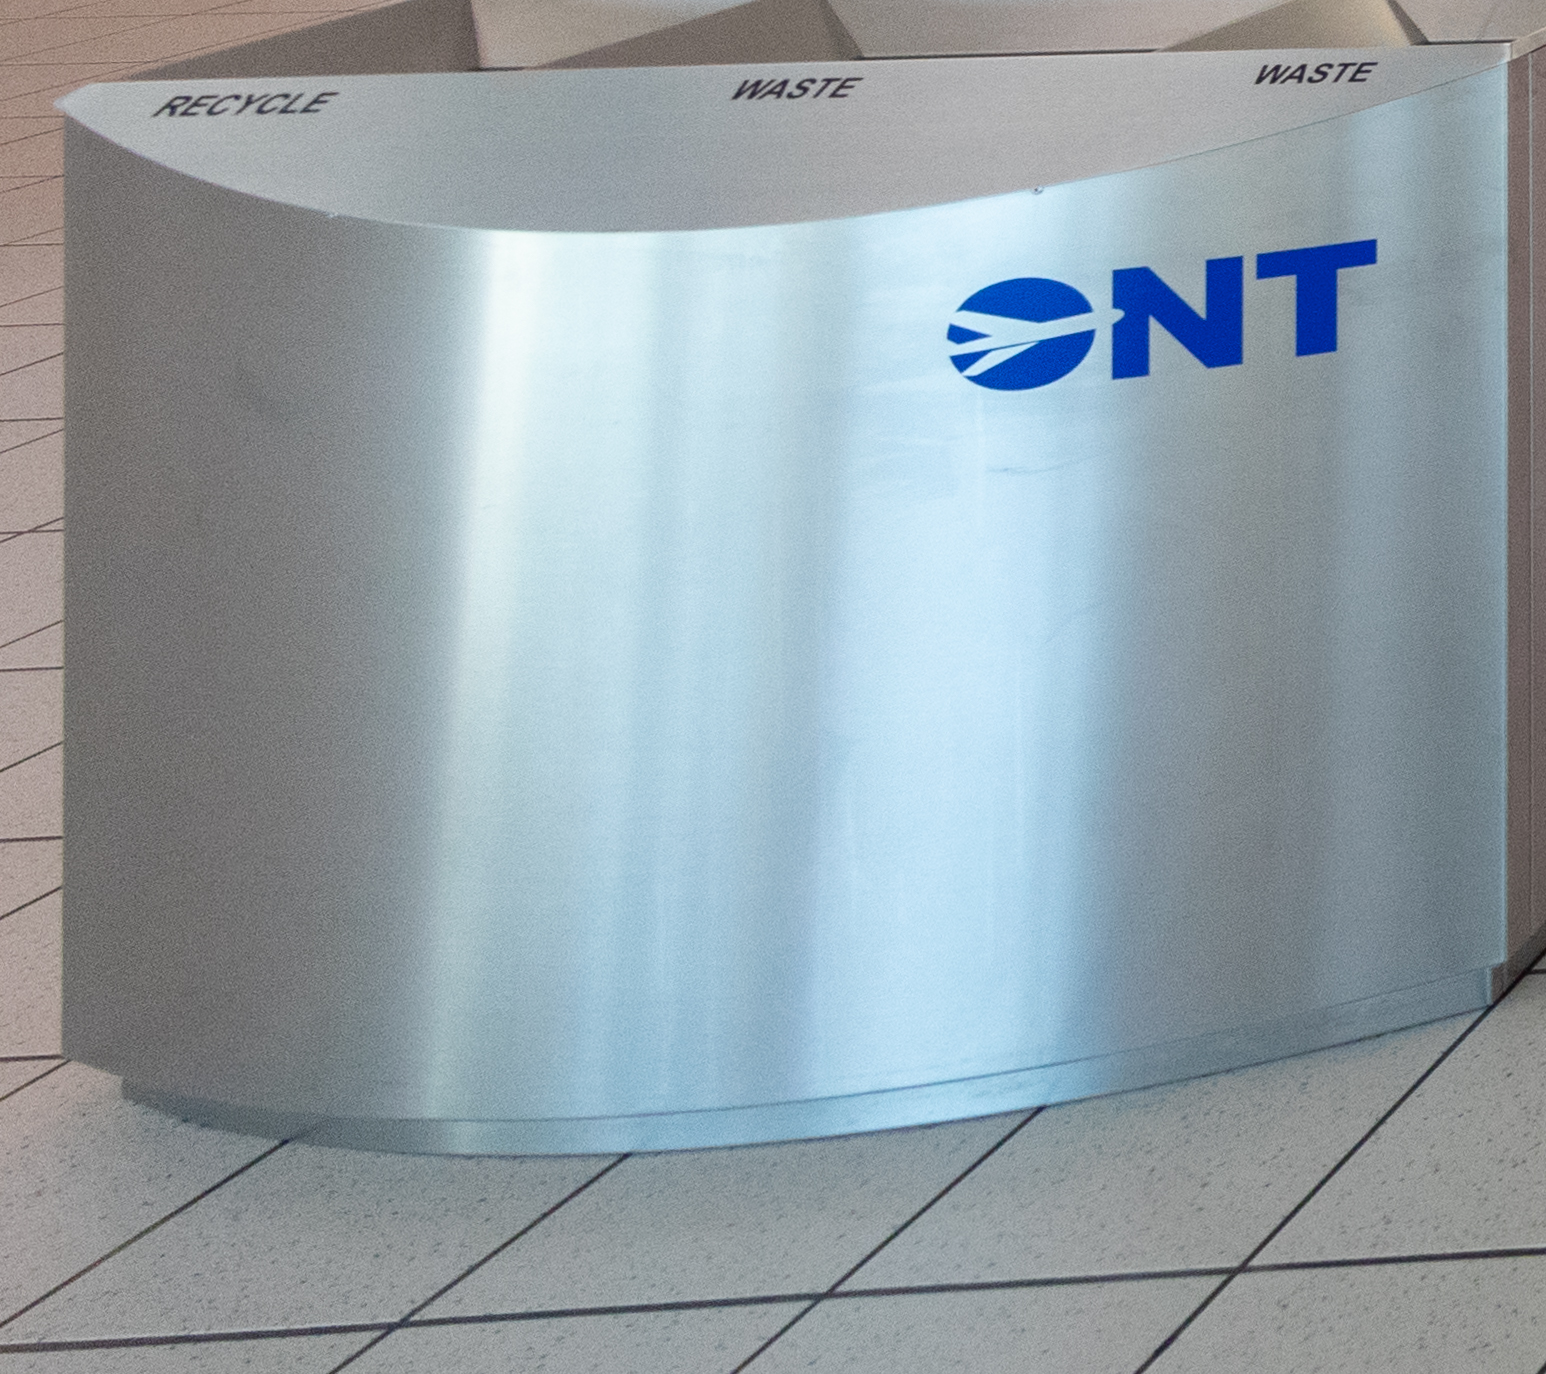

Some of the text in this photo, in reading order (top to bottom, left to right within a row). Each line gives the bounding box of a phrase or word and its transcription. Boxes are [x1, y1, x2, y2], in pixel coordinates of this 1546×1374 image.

[1252, 59, 1379, 86] WASTE
[729, 76, 863, 103] WASTE
[151, 90, 341, 120] RECYCLE
